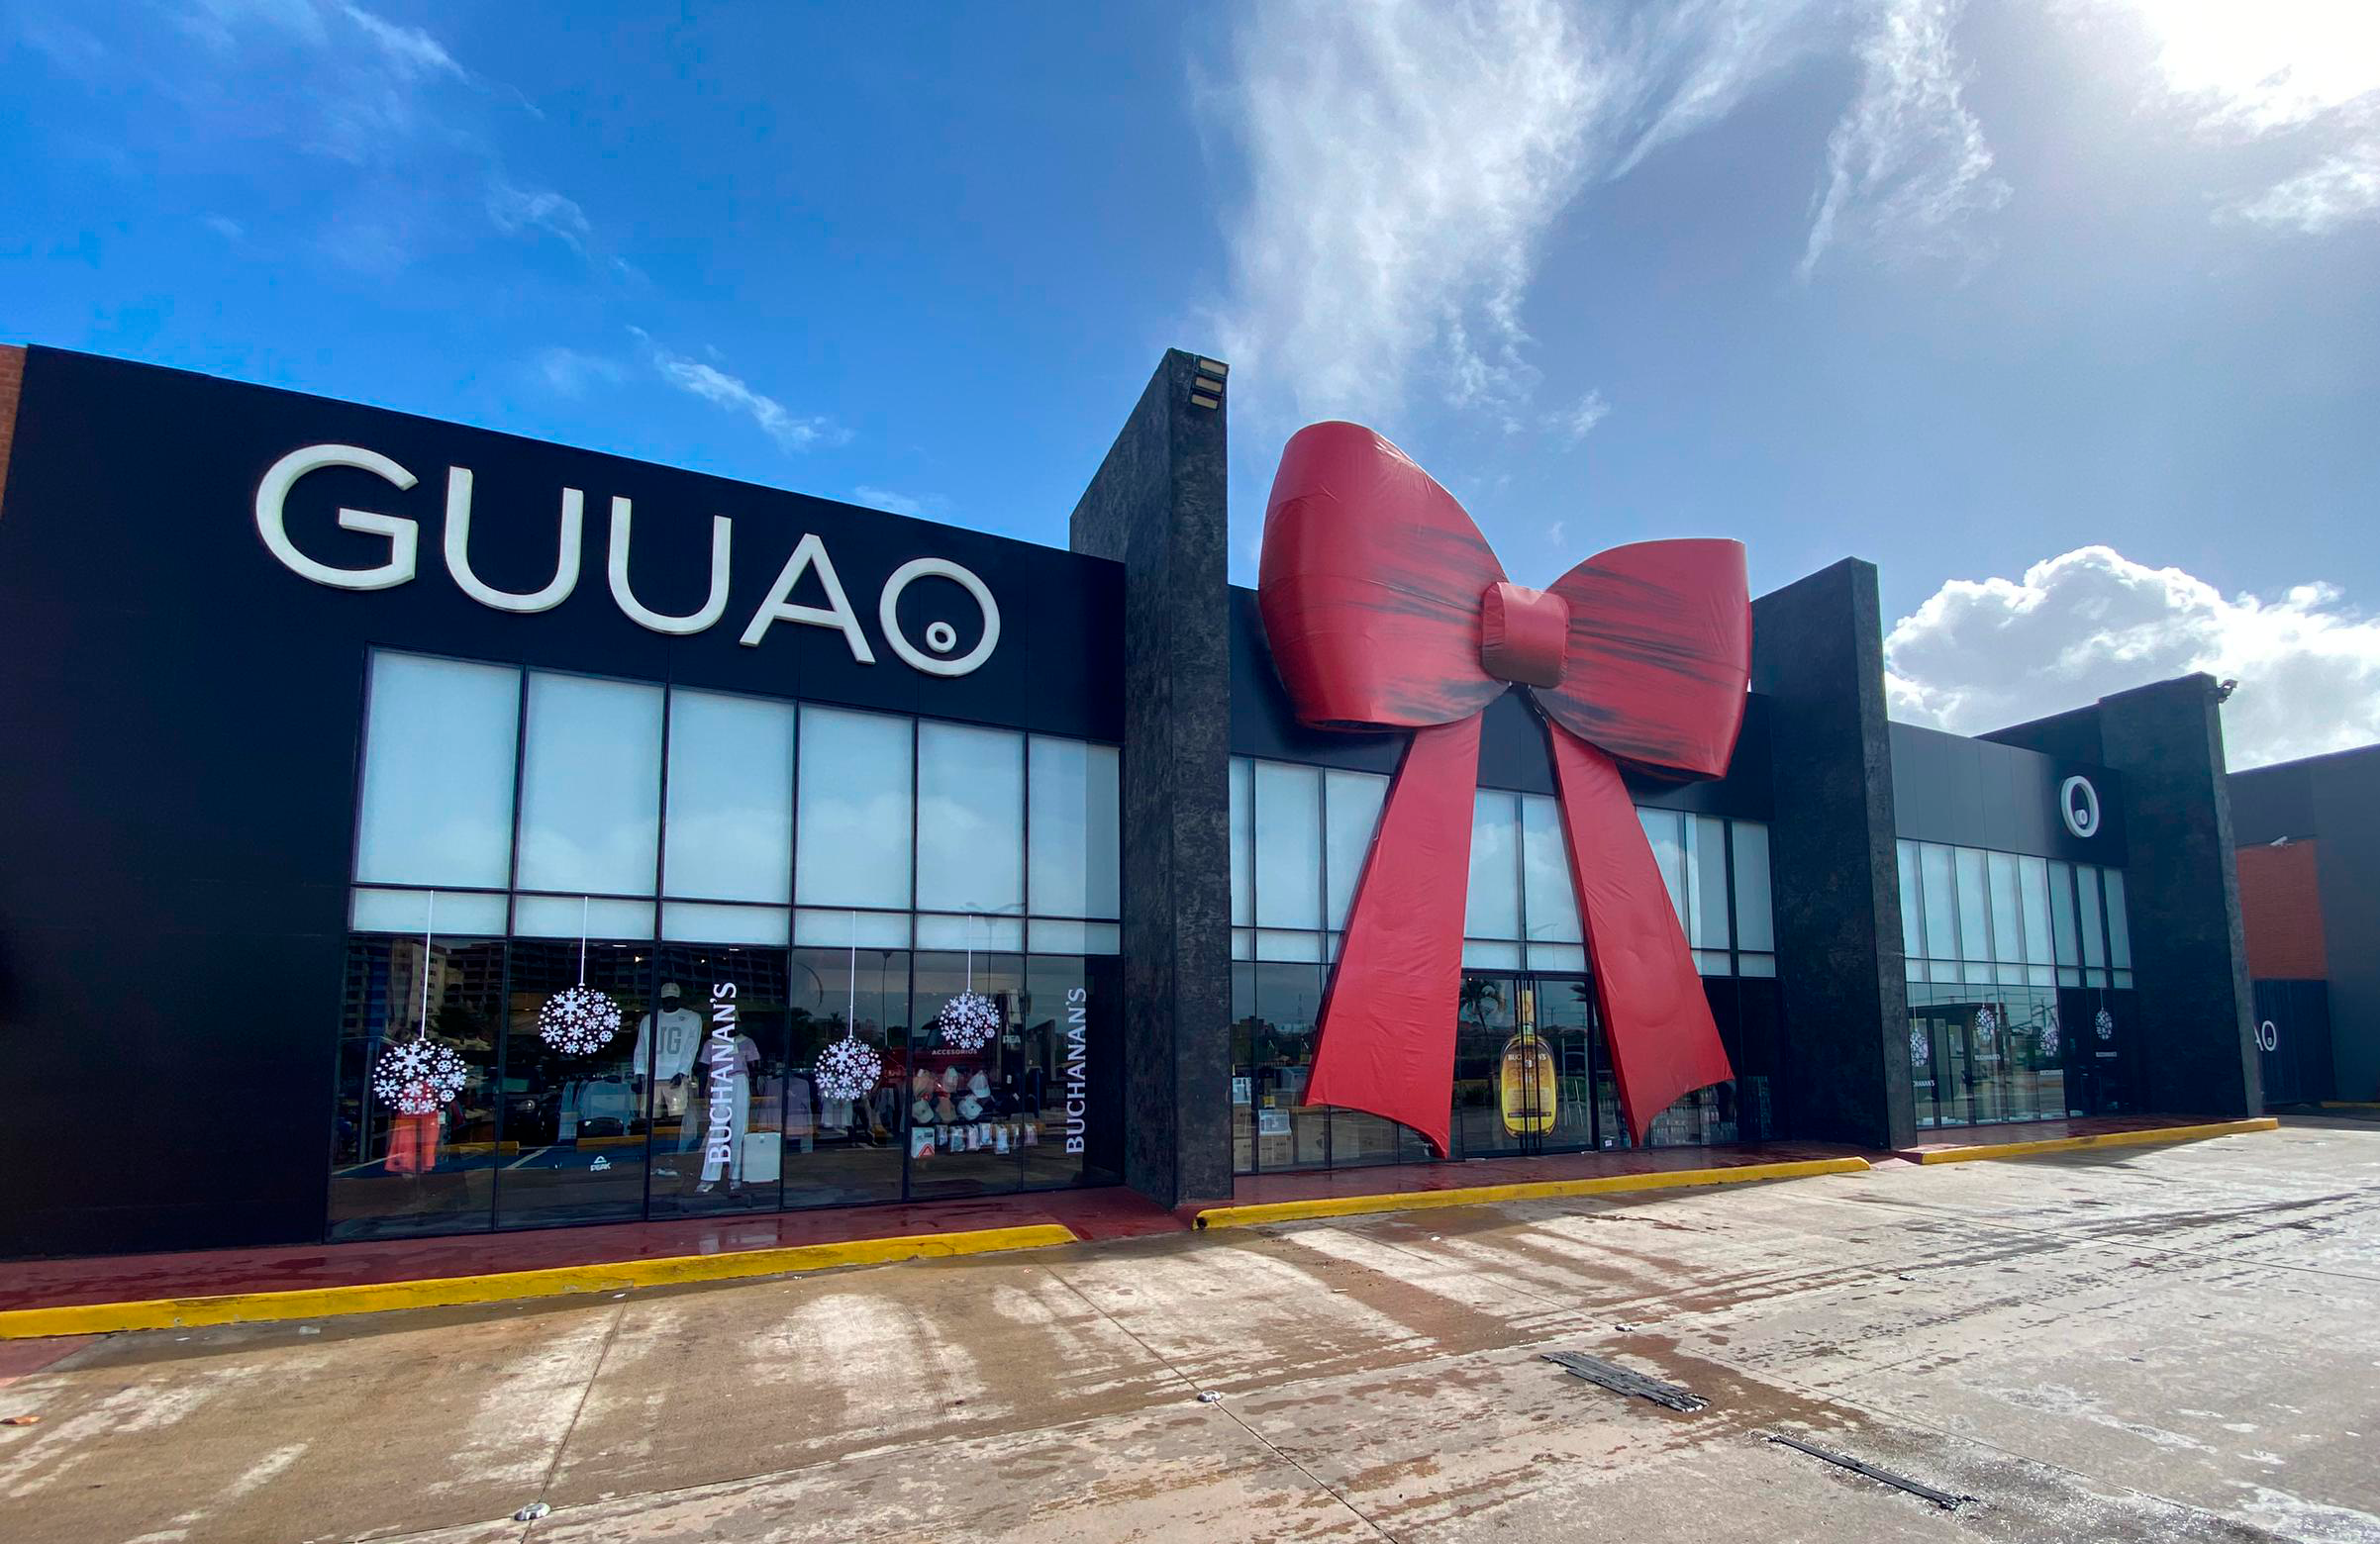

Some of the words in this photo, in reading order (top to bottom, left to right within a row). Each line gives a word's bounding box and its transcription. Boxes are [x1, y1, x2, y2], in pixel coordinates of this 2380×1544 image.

[255, 443, 1001, 677] GUUAO
[708, 982, 738, 1165] BUCHANAN'S
[1065, 988, 1087, 1154] BUCHANAN'S
[590, 1162, 612, 1172] PEAK
